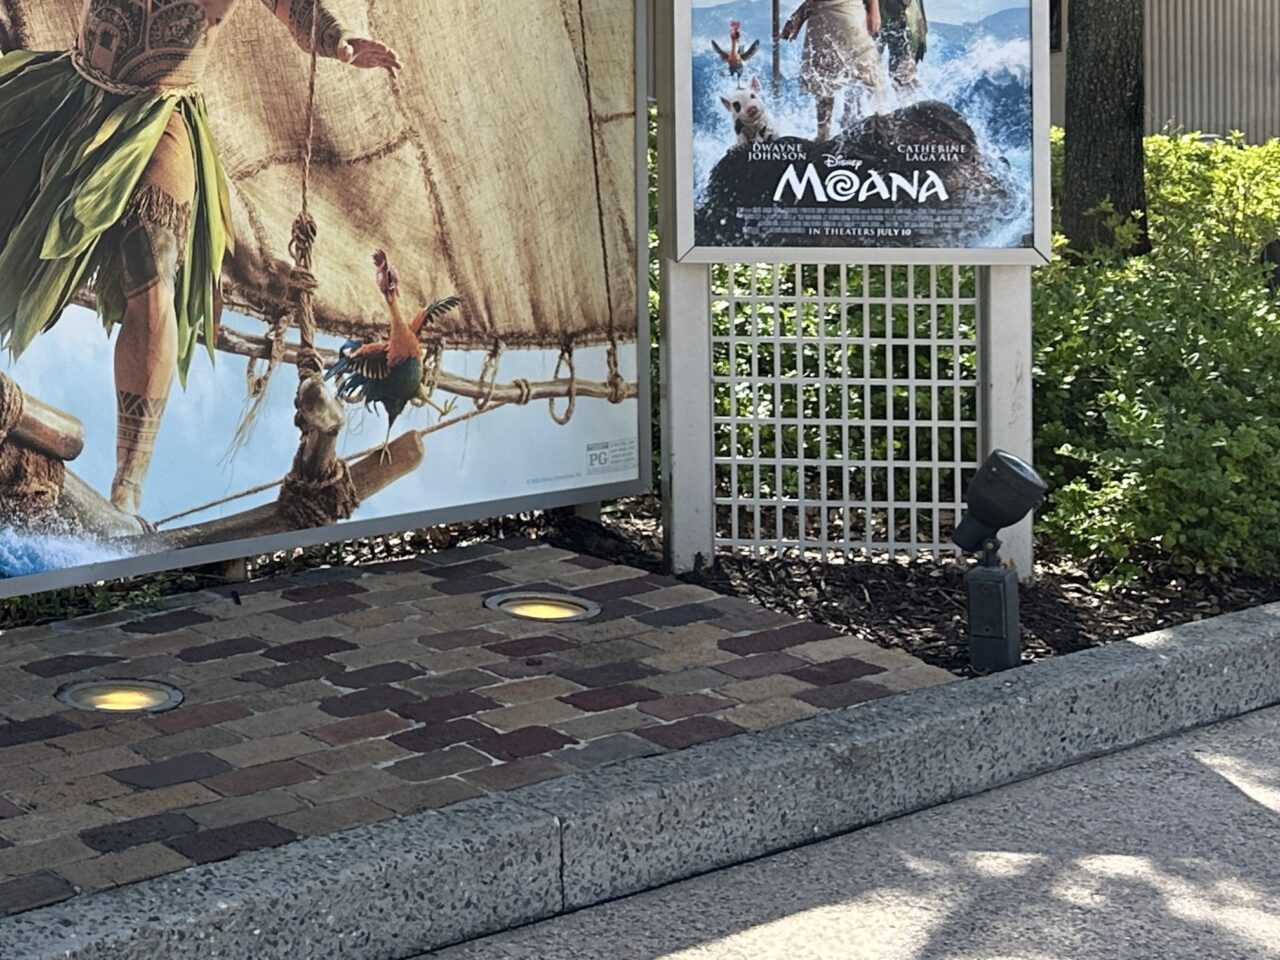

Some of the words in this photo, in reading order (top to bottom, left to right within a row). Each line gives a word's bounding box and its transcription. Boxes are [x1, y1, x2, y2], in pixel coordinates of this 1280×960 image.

[752, 143, 803, 152] DWAYNE
[897, 144, 967, 153] CATHERINE
[748, 152, 807, 161] JOHNSON
[773, 163, 949, 203] MOANA
[808, 227, 820, 236] IN
[824, 227, 875, 236] THEATERS
[877, 228, 899, 237] JULY
[901, 228, 912, 236] 10
[589, 451, 608, 466] PG
